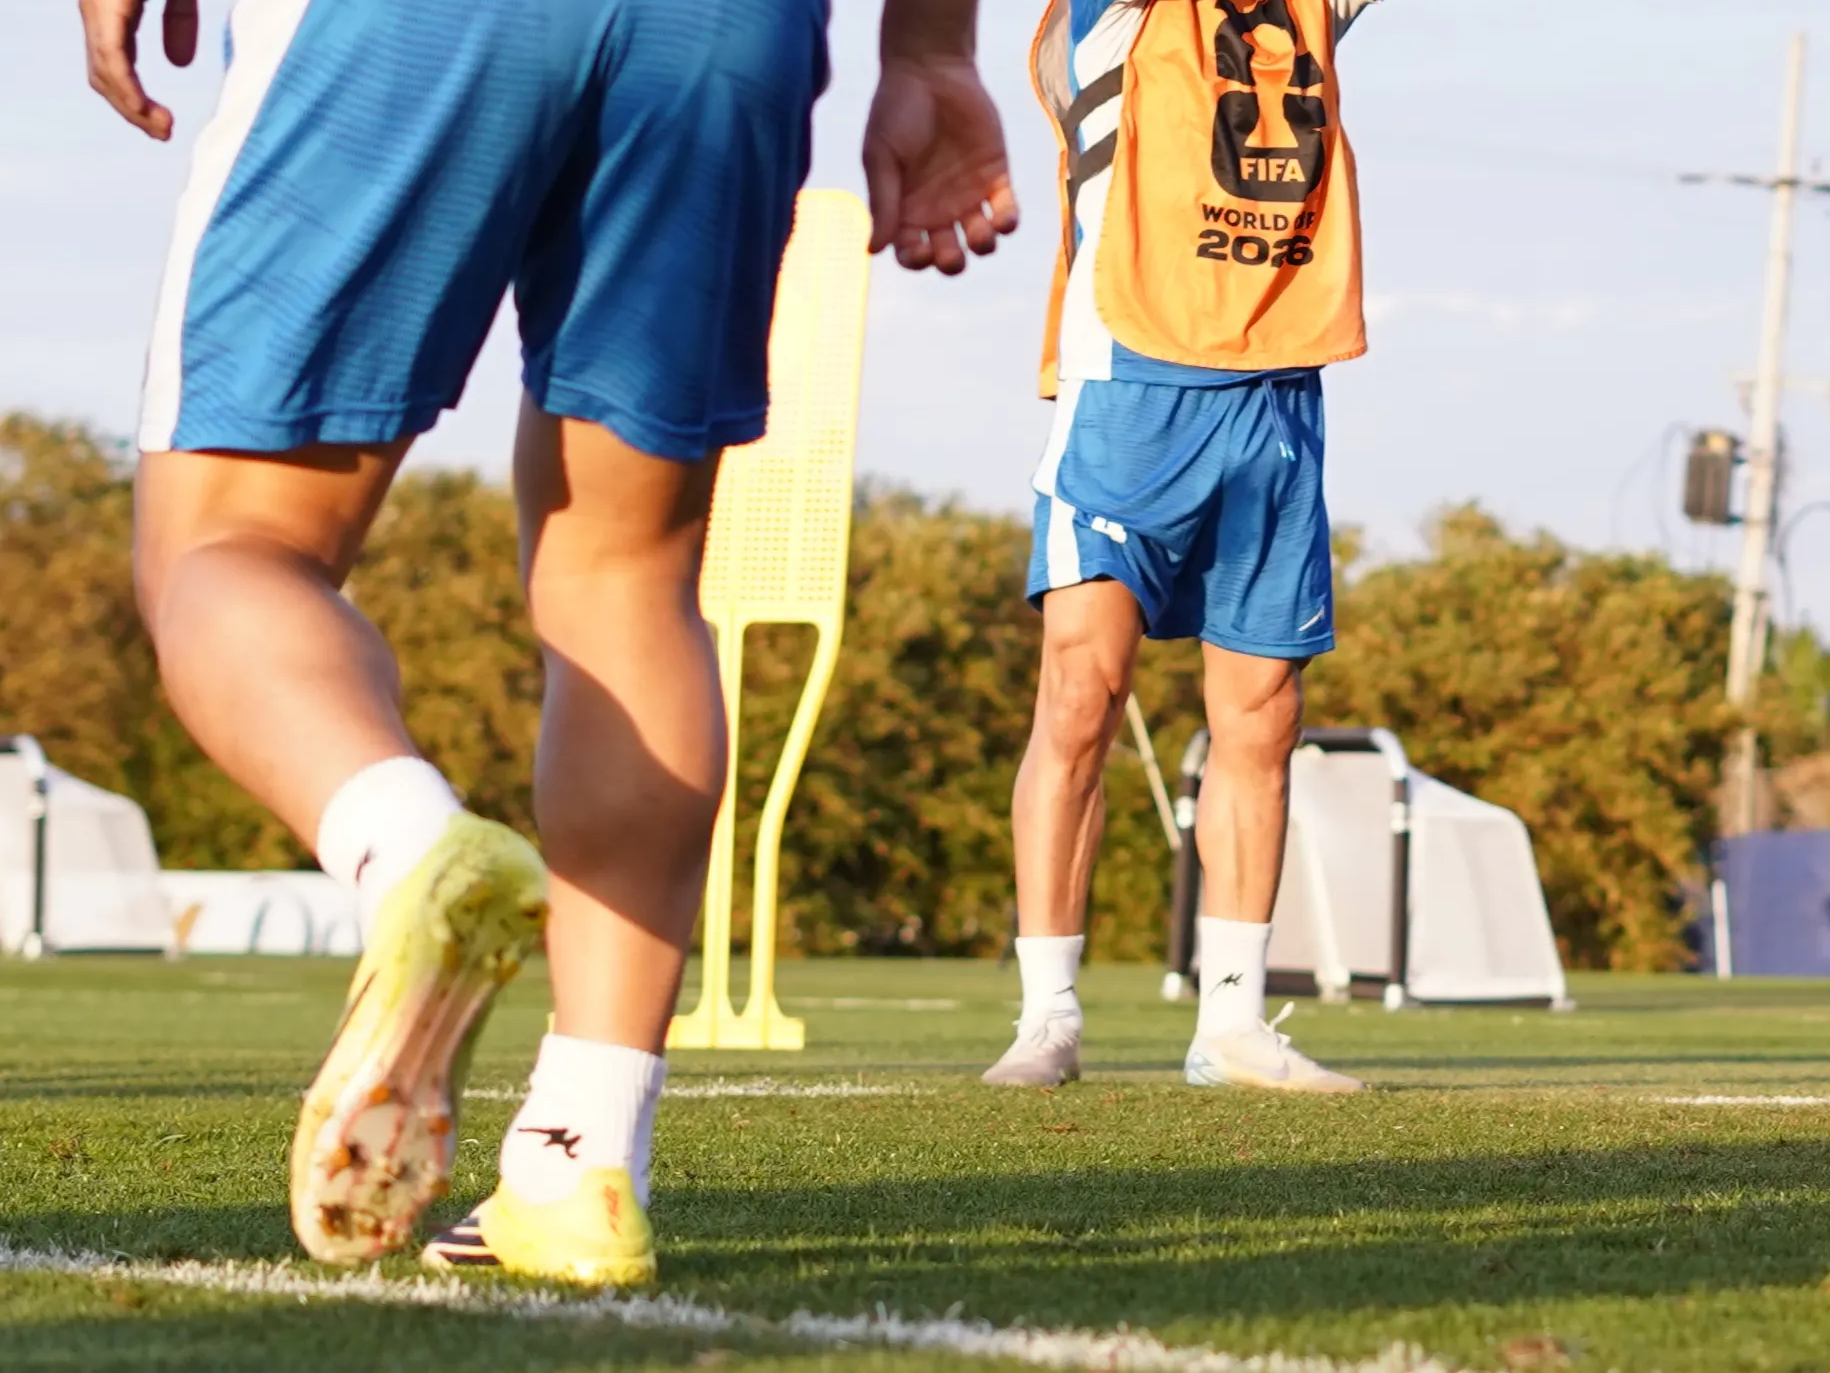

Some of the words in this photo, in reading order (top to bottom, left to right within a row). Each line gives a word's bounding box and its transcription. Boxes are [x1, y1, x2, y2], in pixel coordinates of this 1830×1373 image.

[1240, 156, 1306, 183] FIFA
[1202, 203, 1290, 232] WORLD
[1196, 228, 1314, 269] 2026
